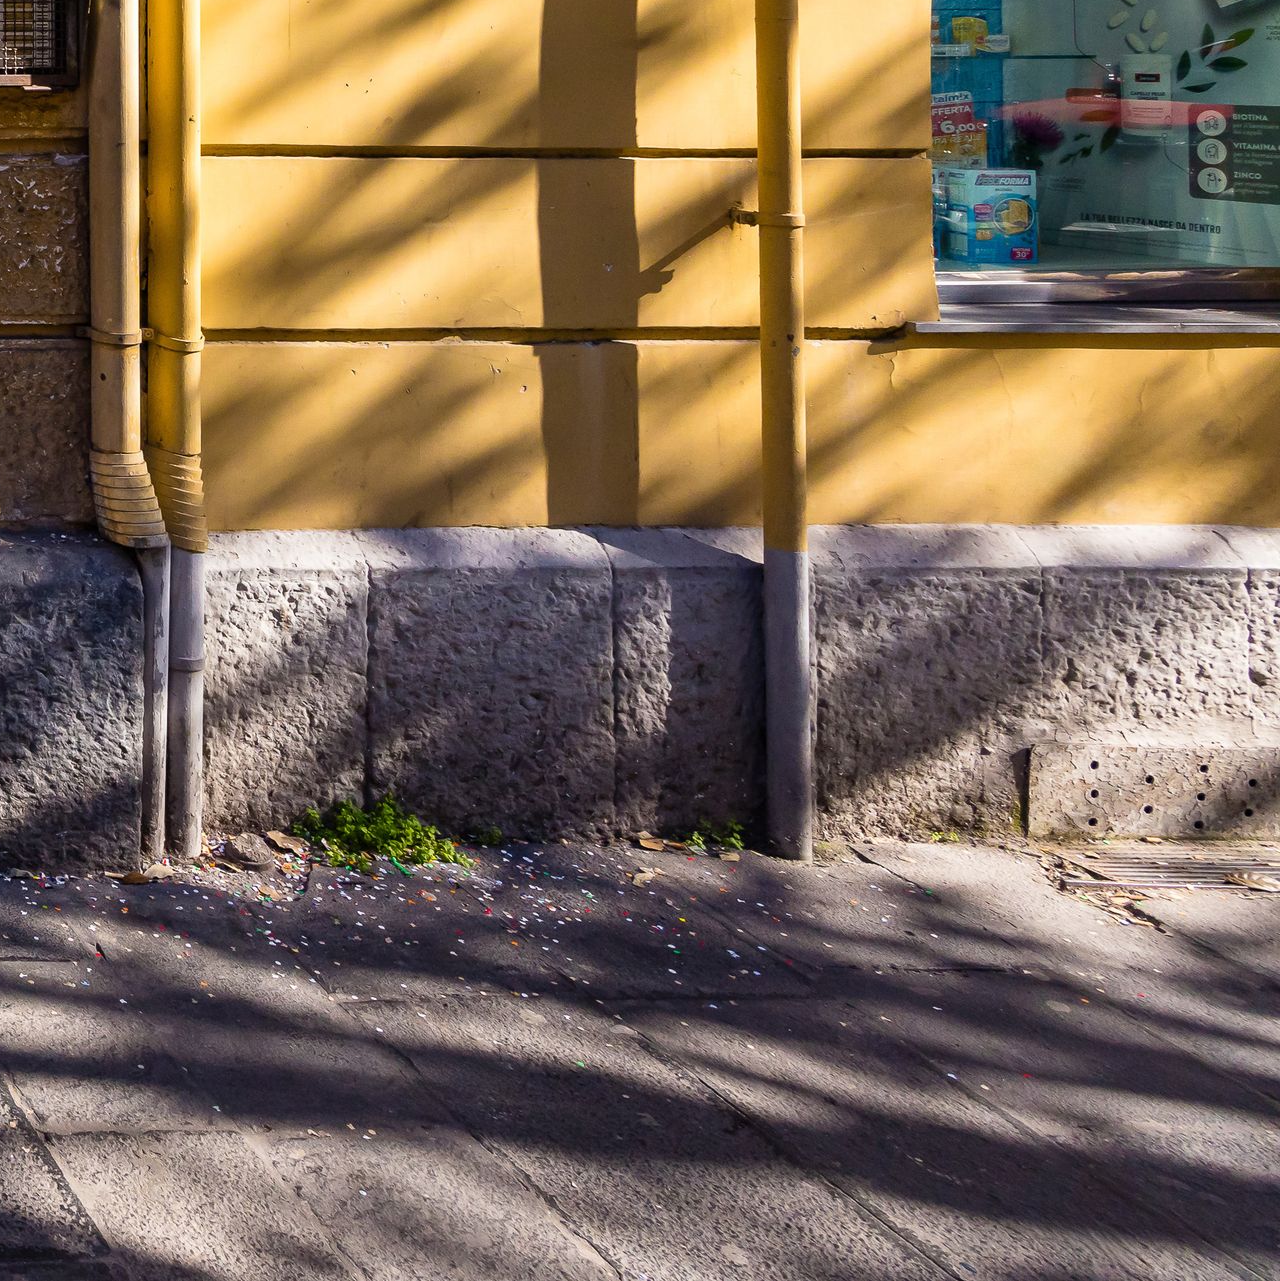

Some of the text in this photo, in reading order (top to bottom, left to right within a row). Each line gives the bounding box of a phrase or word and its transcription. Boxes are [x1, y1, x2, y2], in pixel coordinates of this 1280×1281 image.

[932, 105, 971, 116] FFERTA
[1232, 113, 1268, 121] BIOTINA
[1233, 142, 1277, 151] VITAMINA
[1233, 171, 1262, 180] ZINCO
[1148, 219, 1174, 229] NASCE
[1176, 222, 1186, 230] DA
[1189, 222, 1221, 234] DENTRO
